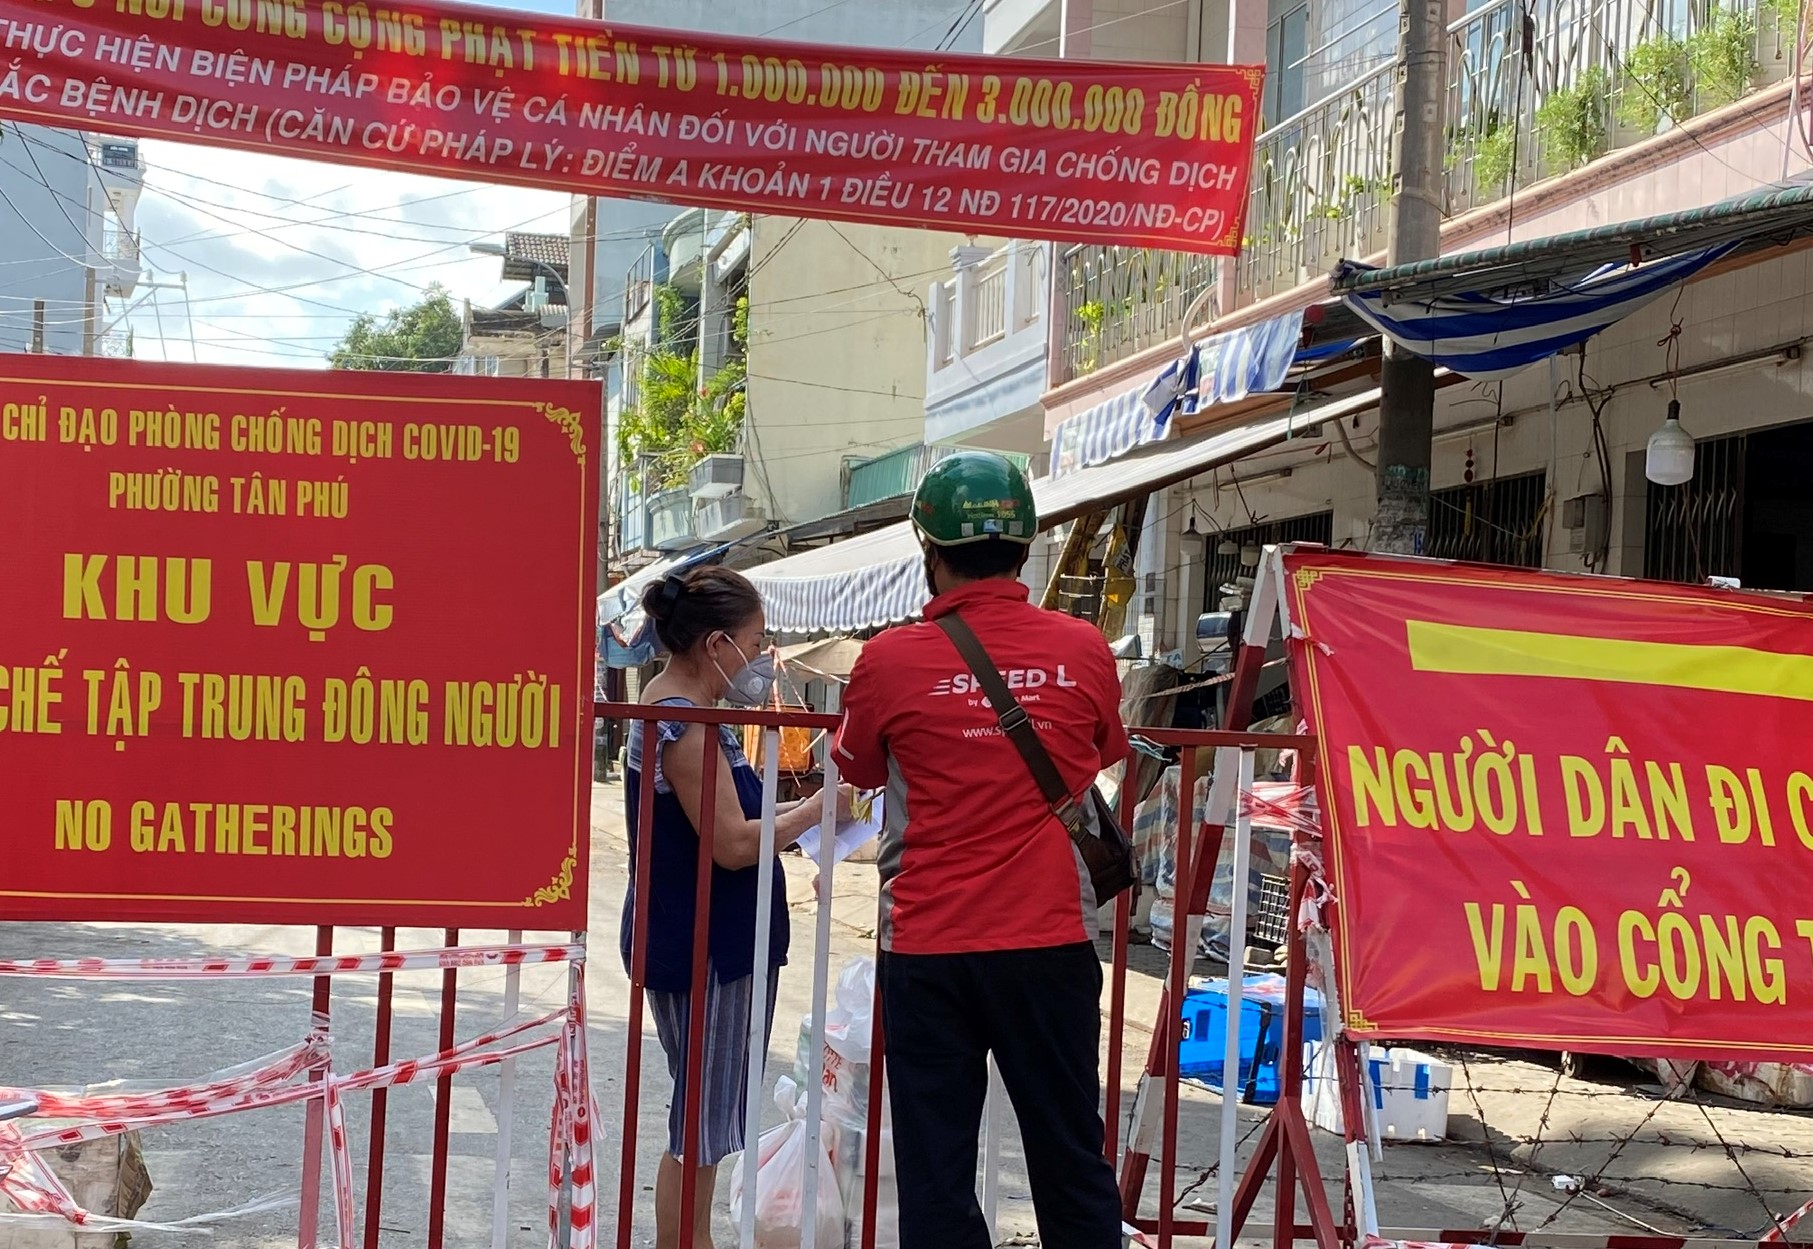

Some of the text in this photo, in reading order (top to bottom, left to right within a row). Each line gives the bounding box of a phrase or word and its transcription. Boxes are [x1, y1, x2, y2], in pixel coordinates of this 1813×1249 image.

[95, 35, 181, 72] HIỆN
[190, 49, 275, 87] BIỆN
[283, 66, 378, 98] PHÁP
[387, 72, 460, 111] BẢO
[475, 87, 514, 122] VỆ
[523, 96, 568, 125] CÁ
[579, 103, 671, 138] NHÂN
[679, 111, 735, 144] ĐỐI
[746, 119, 796, 150] VỚI
[805, 129, 904, 160] NGƯỜI
[912, 139, 992, 169] THAM
[1000, 147, 1046, 174] GIA
[1056, 146, 1160, 184] CHỐNG
[1169, 161, 1239, 192] DỊCH
[323, 2, 426, 59] CỘNG
[440, 20, 536, 77] PHẠT
[552, 29, 639, 84] TIỀN
[654, 45, 697, 91] TỪ
[712, 54, 884, 111] 1.000.000
[895, 64, 970, 121] ĐẾN
[977, 75, 1145, 135] 3.000.000
[1155, 79, 1242, 143] ĐỒNG
[60, 76, 164, 119] BỆNH
[171, 96, 259, 132] DỊCH
[266, 107, 354, 144] (CĂN
[363, 117, 416, 151] CỨ
[420, 130, 514, 163] PHÁP
[520, 139, 573, 172] LÝ:
[581, 142, 662, 182] ĐIỂM
[666, 160, 687, 186] A
[698, 161, 810, 198] KHOẢN
[820, 177, 831, 200] 1
[841, 171, 913, 208] ĐIỀU
[923, 186, 951, 212] 12
[959, 189, 1000, 216] NĐ
[1010, 194, 1225, 240] 117/2020/NĐ-CP)
[3, 396, 519, 463] CHỈ ĐẠO PHÒNG CHỐNG DỊCH COVID-19
[110, 468, 348, 518] PHƯỜNG TÂN PHÚ
[64, 554, 393, 641] KHU VỰC
[83, 658, 161, 751] TẬP
[179, 673, 305, 742] TRUNG
[323, 666, 428, 745] ĐÔNG
[445, 671, 560, 748] NGƯỜI
[968, 698, 978, 707] by
[1056, 665, 1077, 687] L
[56, 800, 393, 858] NO GATHERINGS
[1348, 729, 1543, 835] NGƯỜI
[1560, 736, 1695, 841] DÂN
[1706, 765, 1775, 846] ĐI
[1464, 881, 1597, 995] VÀO
[1618, 867, 1785, 1004] CỔNG
